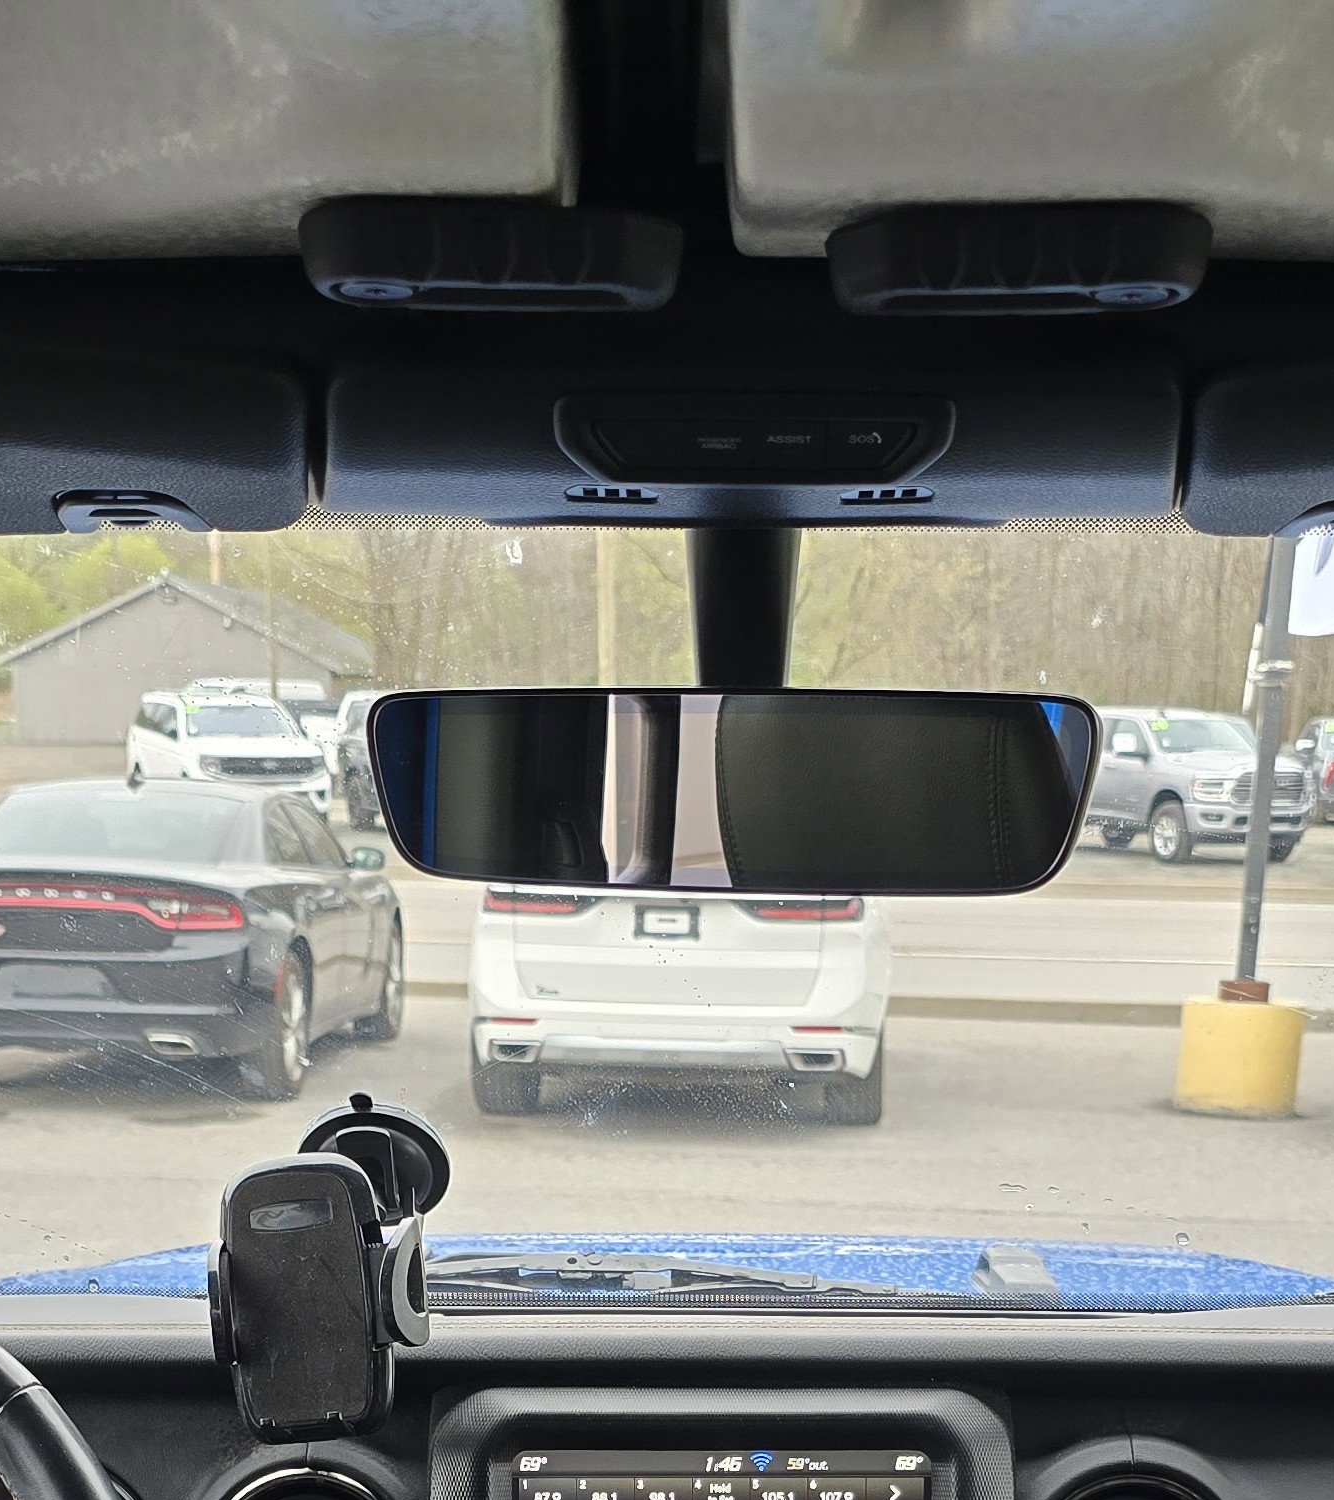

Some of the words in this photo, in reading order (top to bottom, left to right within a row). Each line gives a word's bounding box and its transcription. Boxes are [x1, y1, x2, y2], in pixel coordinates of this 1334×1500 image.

[849, 435, 874, 444] SOS
[522, 1480, 528, 1490] 1
[579, 1480, 587, 1490] 2
[636, 1480, 644, 1490] 3
[694, 1480, 702, 1490] 4
